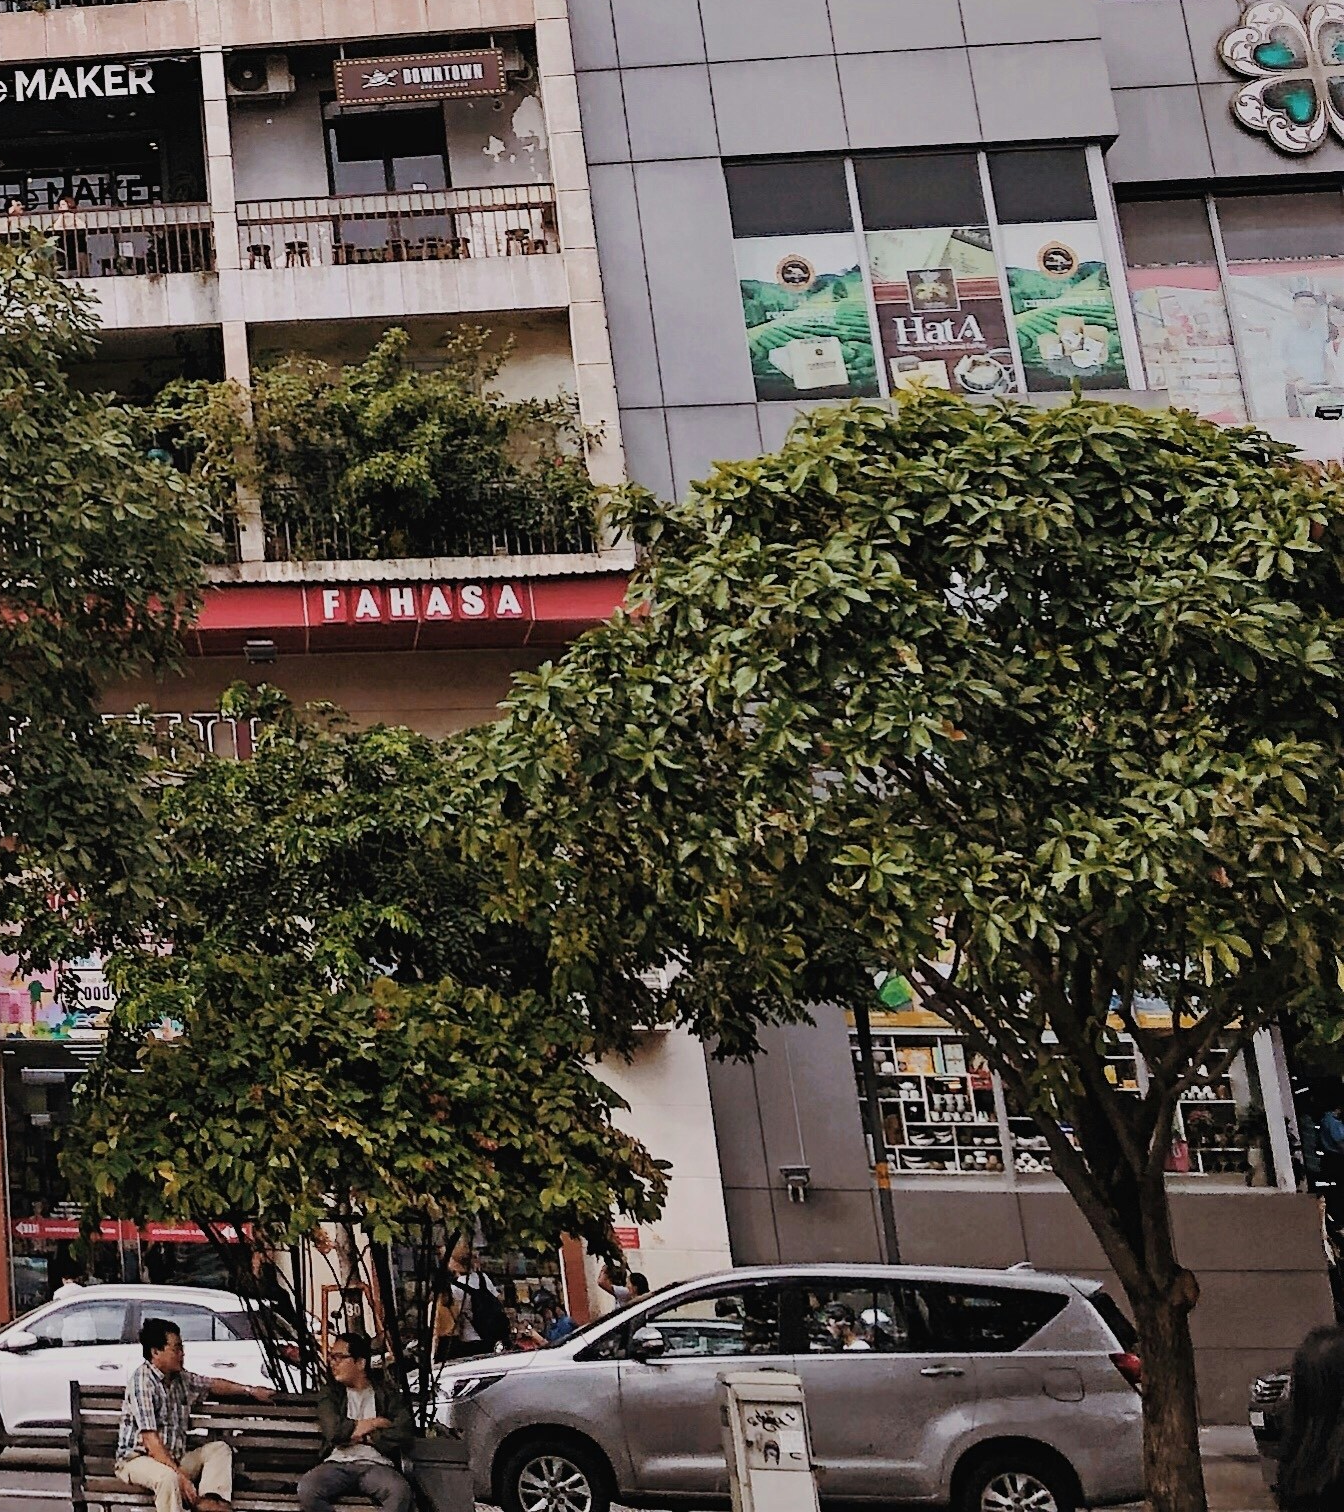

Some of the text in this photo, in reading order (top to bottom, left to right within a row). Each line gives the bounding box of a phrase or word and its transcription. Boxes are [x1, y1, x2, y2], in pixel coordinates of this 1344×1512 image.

[15, 65, 155, 102] MAKER
[402, 63, 483, 84] DOWNTOWN
[323, 585, 522, 621] FAHASA
